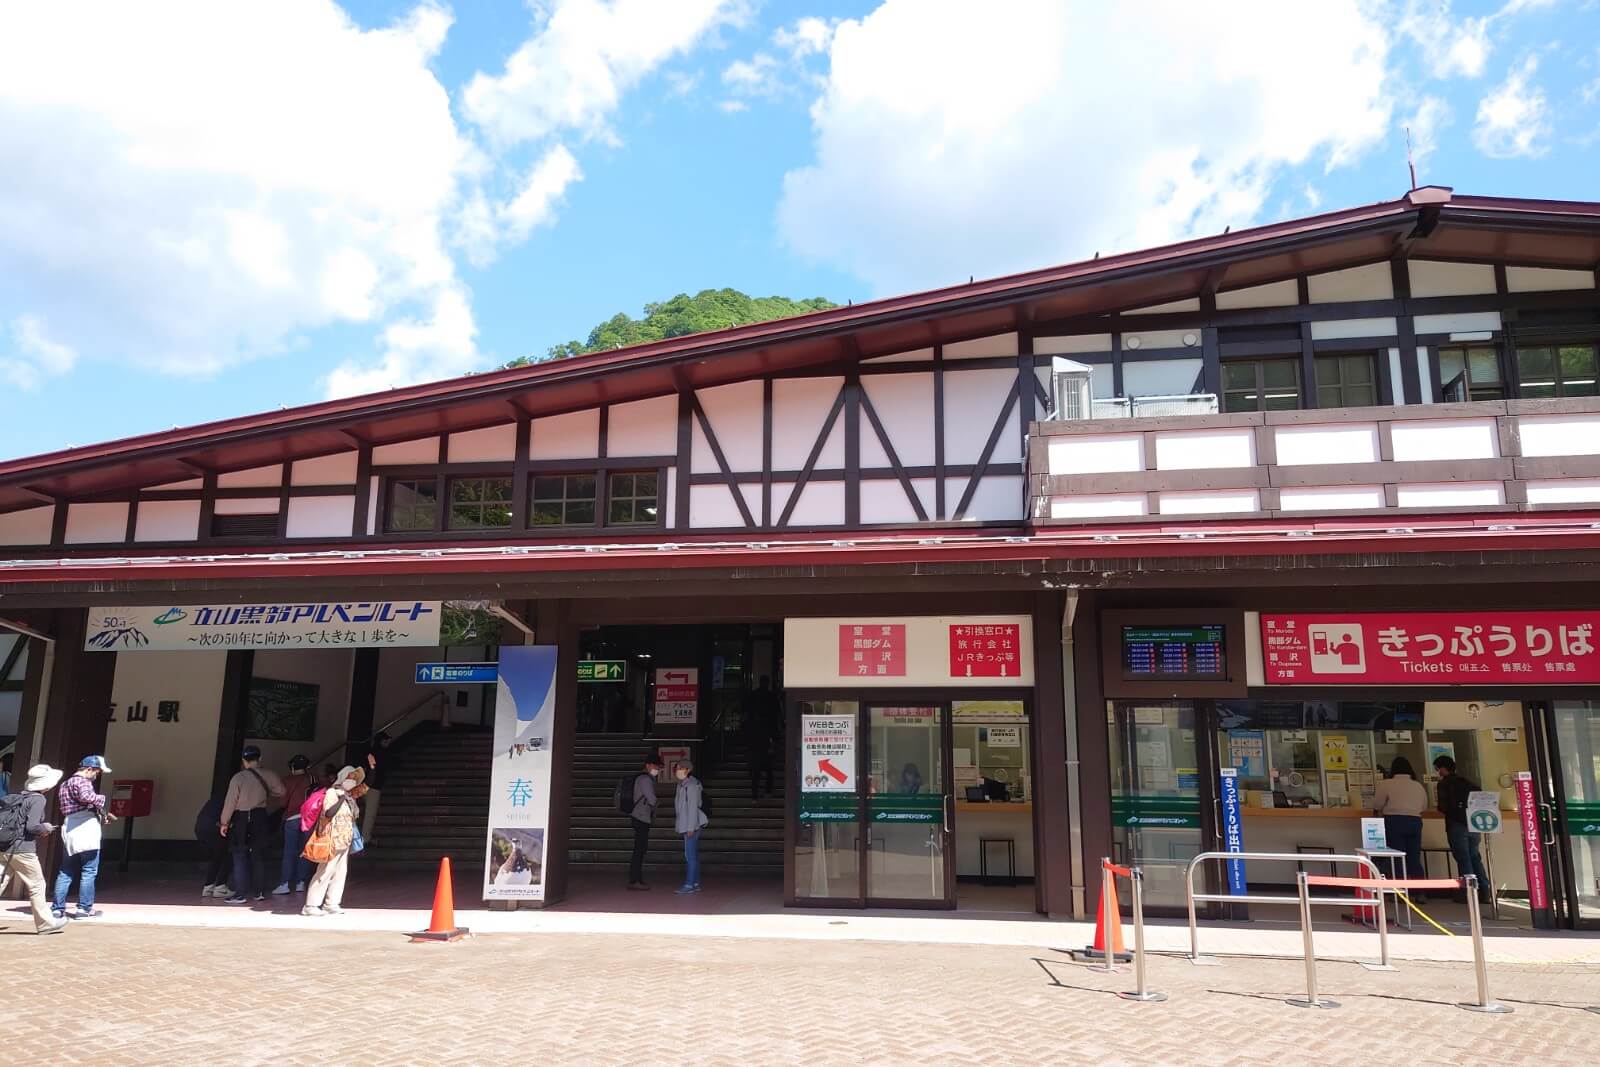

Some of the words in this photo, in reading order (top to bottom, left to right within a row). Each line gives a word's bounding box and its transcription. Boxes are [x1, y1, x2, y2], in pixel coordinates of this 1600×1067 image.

[190, 602, 433, 626] 立山黒部アルペンルート
[958, 639, 1013, 650] 旅行会社
[1377, 624, 1595, 657] きっぷうりば
[1400, 660, 1453, 673] Tickets
[1458, 662, 1491, 672] 매표소
[1277, 670, 1295, 678] 方面
[507, 778, 533, 807] 春
